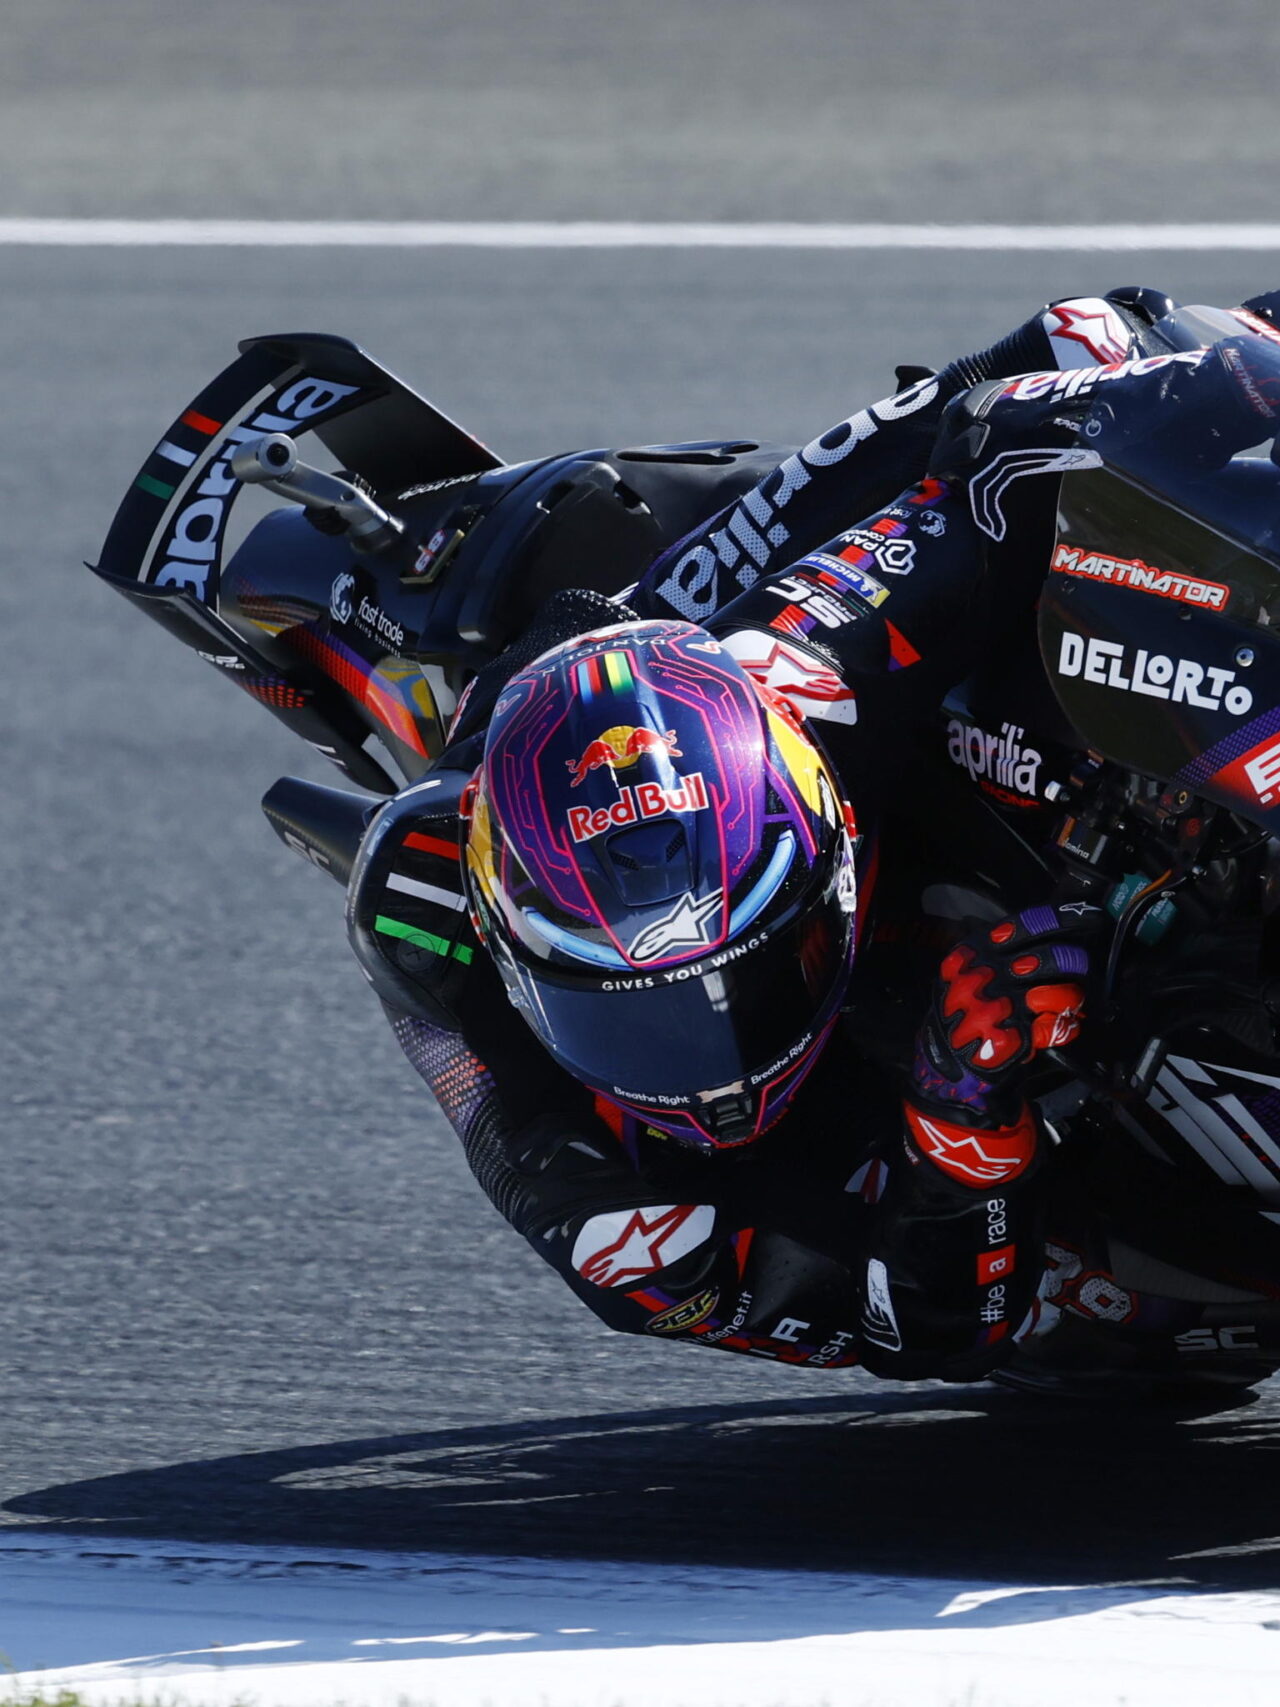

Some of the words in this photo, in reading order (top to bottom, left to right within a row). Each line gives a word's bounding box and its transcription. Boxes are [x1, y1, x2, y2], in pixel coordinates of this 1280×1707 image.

[655, 376, 939, 624] aprilia
[805, 555, 862, 582] MICHELIN
[1053, 546, 1227, 608] MARTINATOR
[358, 595, 379, 627] fast
[378, 610, 404, 646] trade
[765, 577, 851, 629] SC
[1058, 631, 1253, 715] DELLORTO
[946, 719, 1042, 797] aprilia
[567, 786, 637, 843] Red
[635, 772, 709, 819] Bull
[602, 976, 655, 992] GIVES
[664, 966, 703, 984] YOU
[711, 931, 769, 968] WINGS
[750, 1057, 789, 1085] Breathe
[788, 1031, 813, 1059] Right
[613, 1086, 657, 1104] Breathe
[657, 1095, 691, 1107] Right
[986, 1197, 1007, 1246] race
[988, 1256, 1007, 1273] a
[979, 1284, 1006, 1323] #be
[1172, 1324, 1261, 1352] SC
